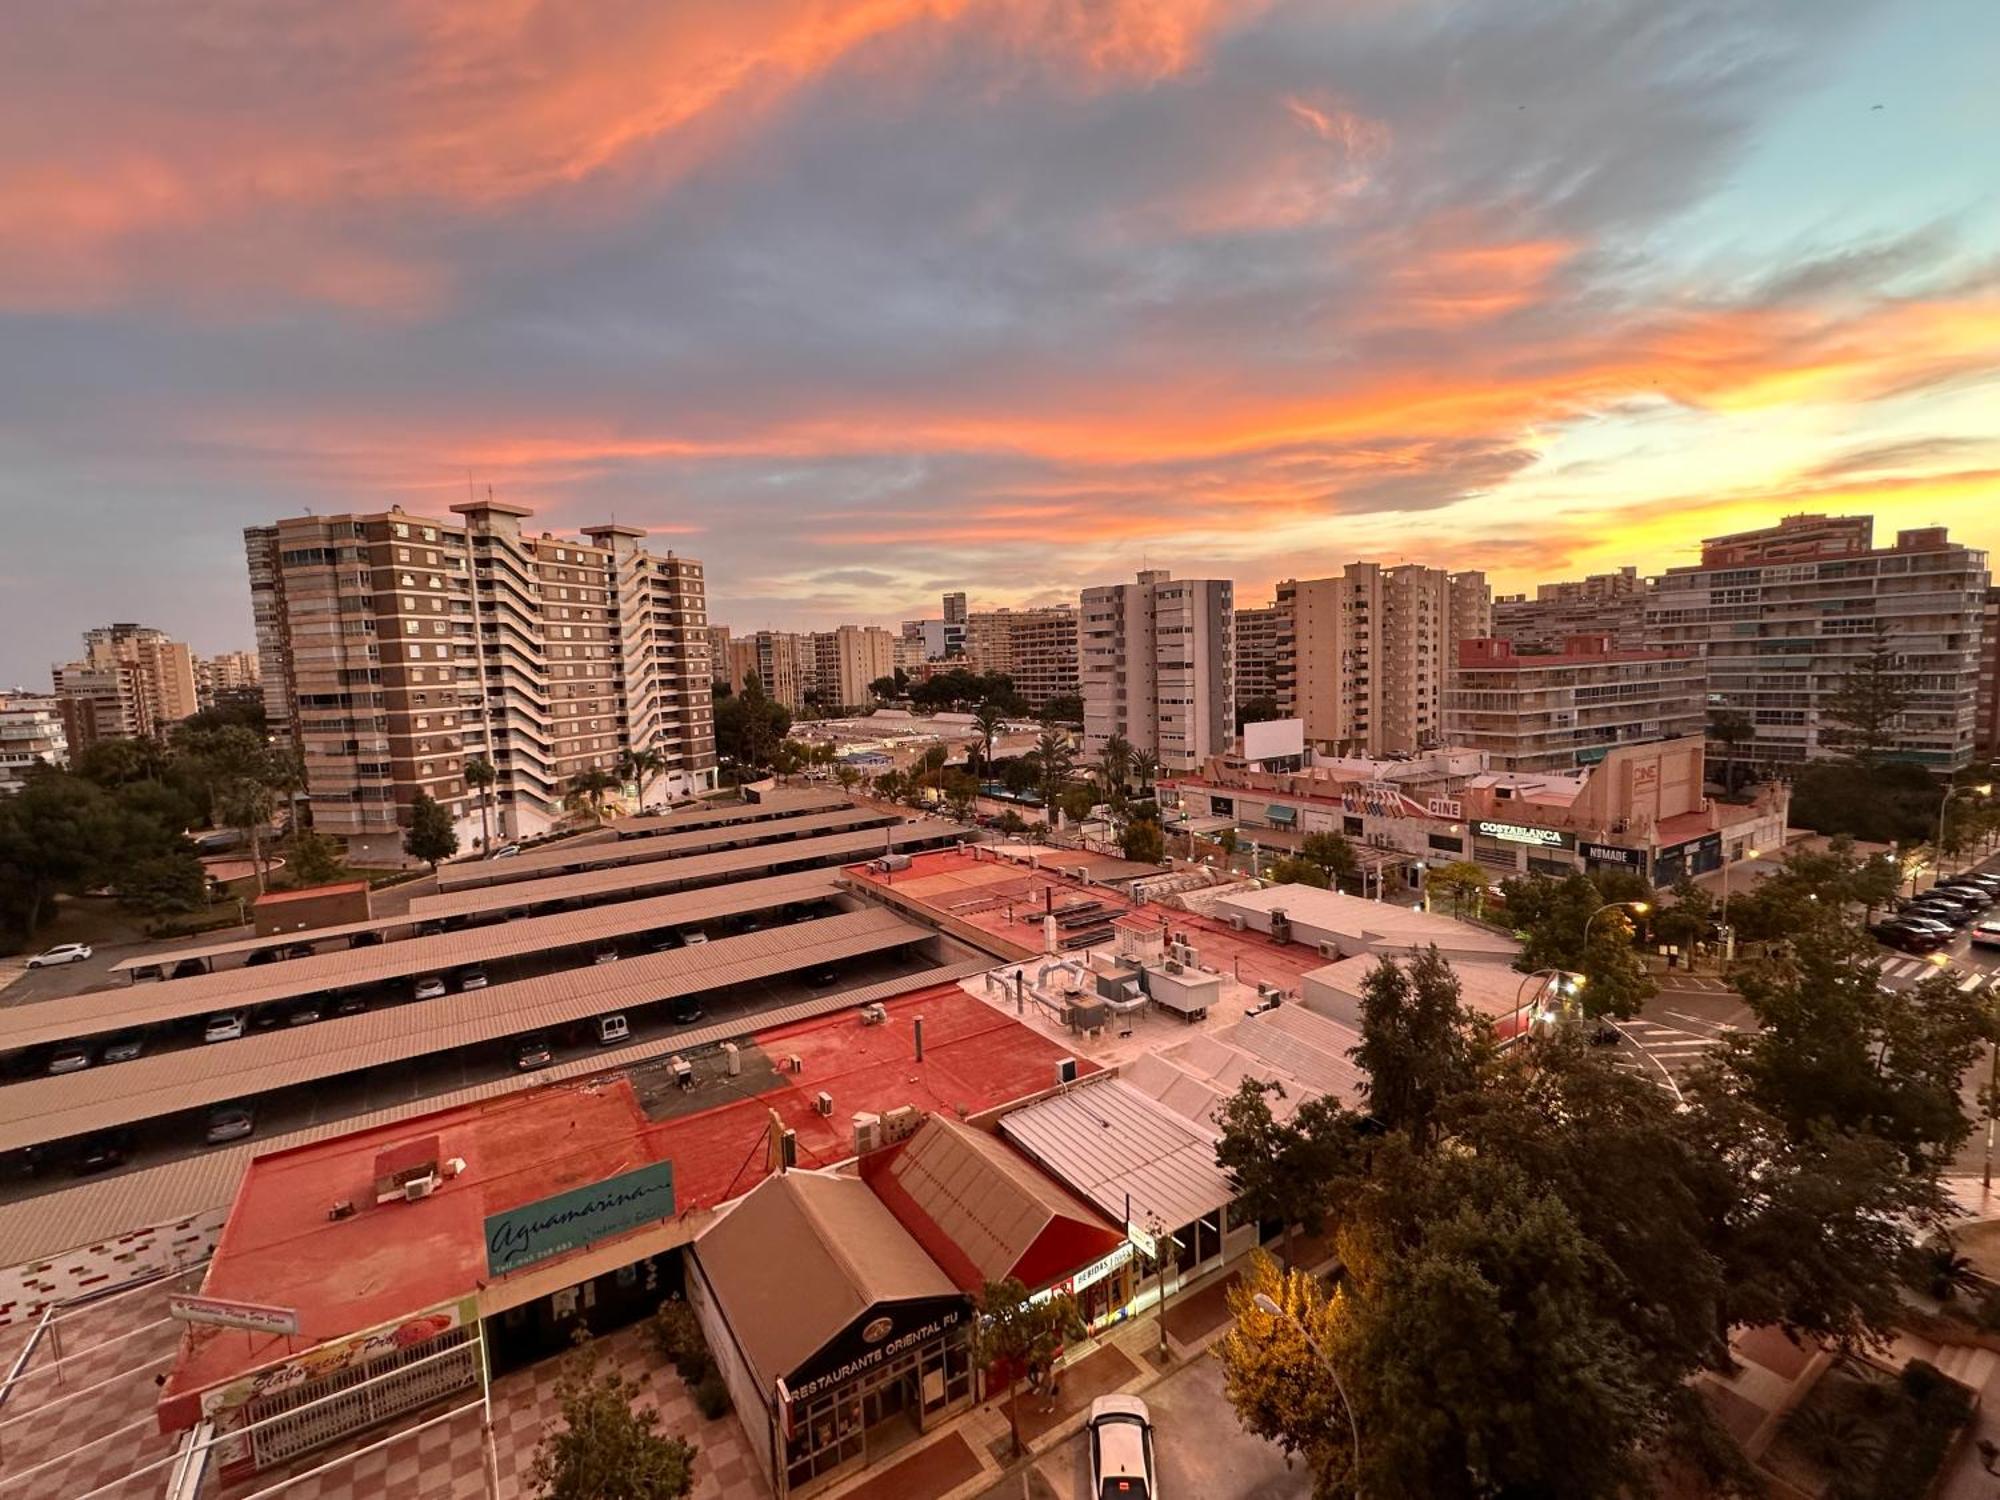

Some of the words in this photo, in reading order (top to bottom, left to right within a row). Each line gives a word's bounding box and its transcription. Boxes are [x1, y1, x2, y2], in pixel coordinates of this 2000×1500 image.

[1633, 764, 1657, 781] CINE
[1429, 801, 1459, 816] CINE
[1479, 821, 1563, 843] COSTABLANCA
[1589, 847, 1628, 863] NOMADE
[1078, 1259, 1108, 1284] BEBIDAS
[790, 1348, 883, 1401] RESTAURANTE
[885, 1321, 941, 1356] ORIENTAL
[943, 1311, 959, 1328] FU
